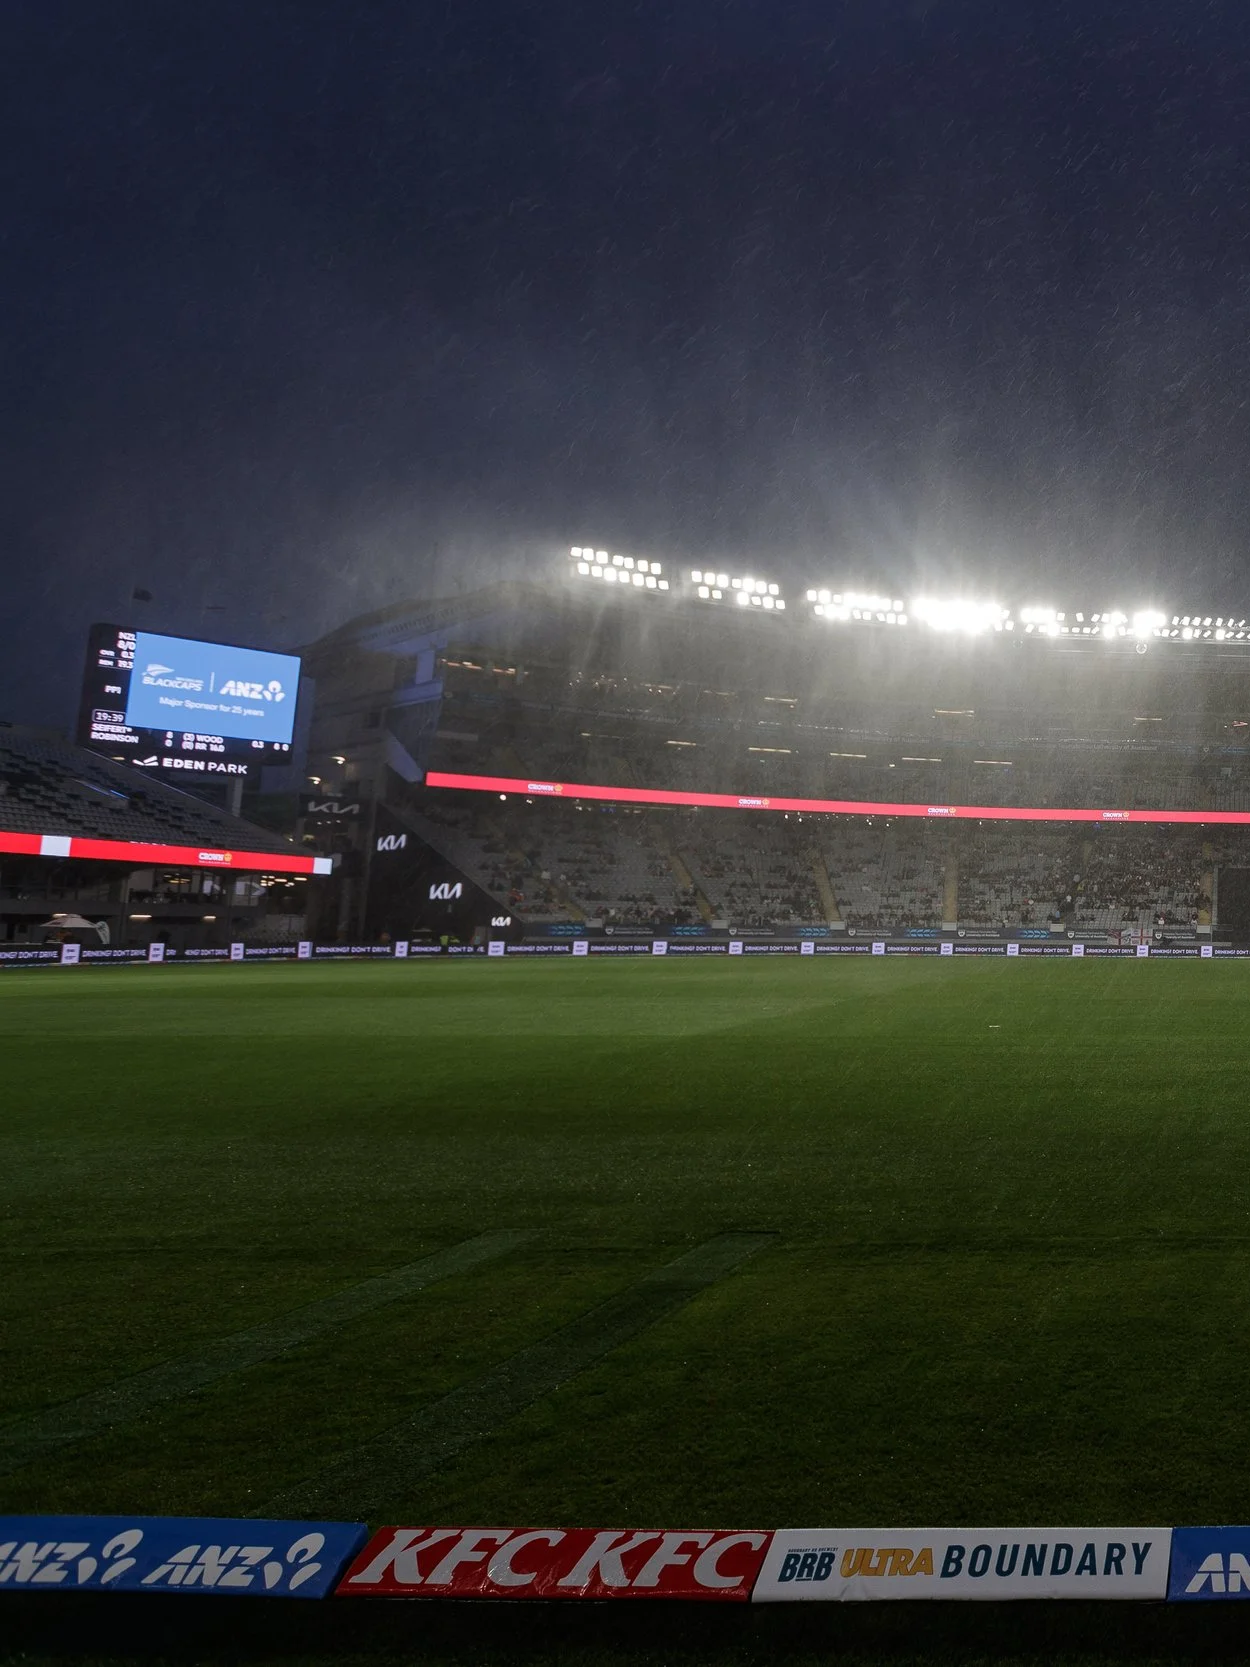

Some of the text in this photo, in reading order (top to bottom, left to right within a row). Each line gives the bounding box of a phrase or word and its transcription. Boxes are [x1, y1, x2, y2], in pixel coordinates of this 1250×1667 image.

[142, 676, 204, 691] BLACKCAPS
[219, 680, 264, 700] ANZ
[159, 697, 264, 716] Major Sponsor for 25 years
[95, 712, 124, 722] 19:39
[91, 732, 139, 743] ROBINSON
[196, 734, 224, 744] WOOD
[162, 757, 248, 774] EDEN PARK
[308, 801, 360, 814] KIA
[377, 834, 407, 852] KIA
[429, 882, 463, 900] KIA
[491, 916, 511, 927] KIA
[141, 1544, 274, 1586] ANZ
[349, 1529, 769, 1589] KFC KFC
[776, 1541, 1154, 1582] BRB ULTRA BOUNDARY
